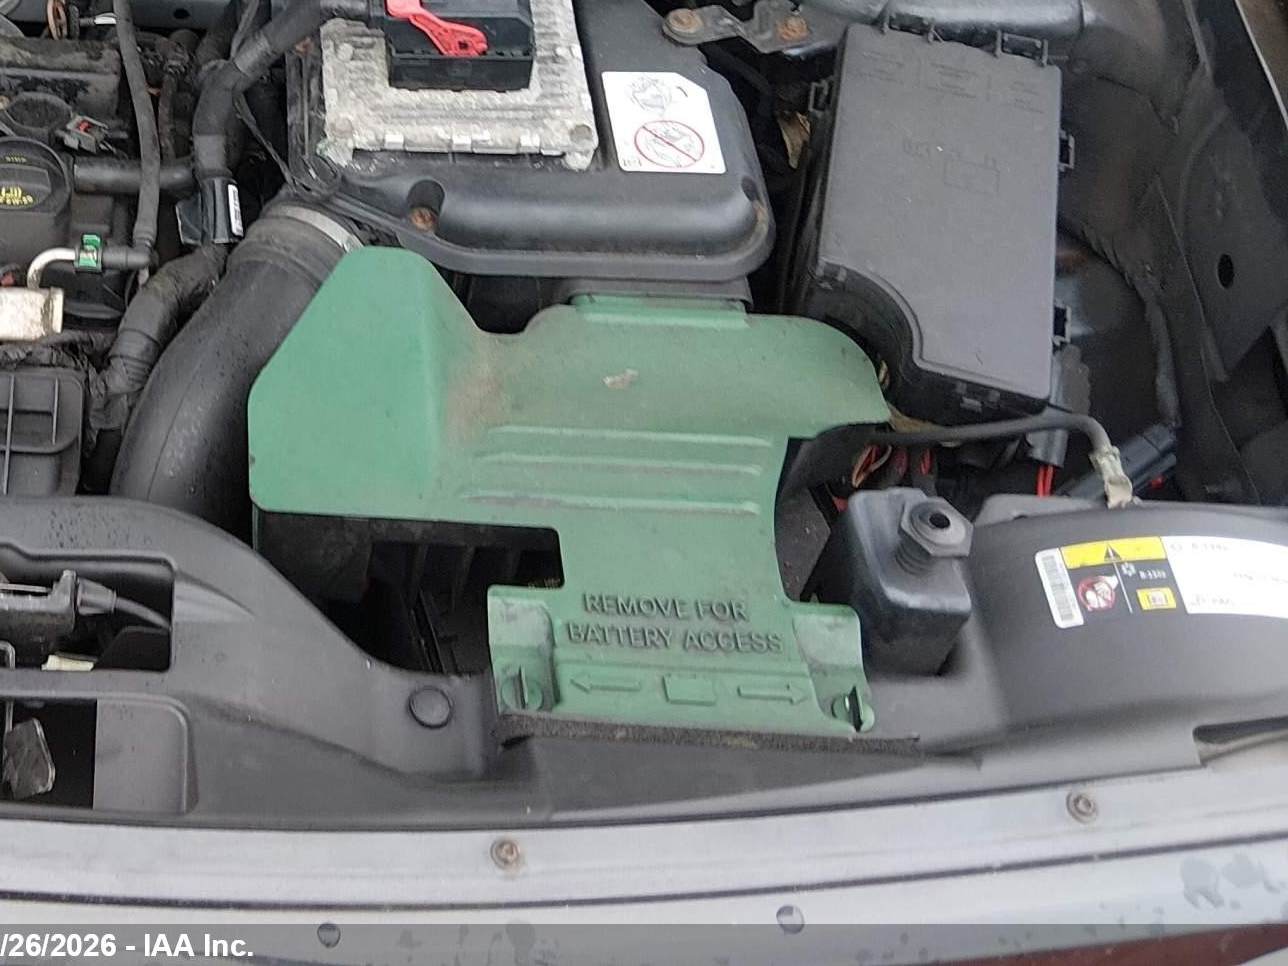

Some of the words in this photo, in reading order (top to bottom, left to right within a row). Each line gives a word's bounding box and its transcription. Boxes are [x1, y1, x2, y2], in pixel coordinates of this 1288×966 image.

[582, 592, 689, 620] REMOVE
[695, 599, 749, 622] FOR
[566, 621, 674, 651] BATTERY
[682, 631, 784, 655] ACCESS
